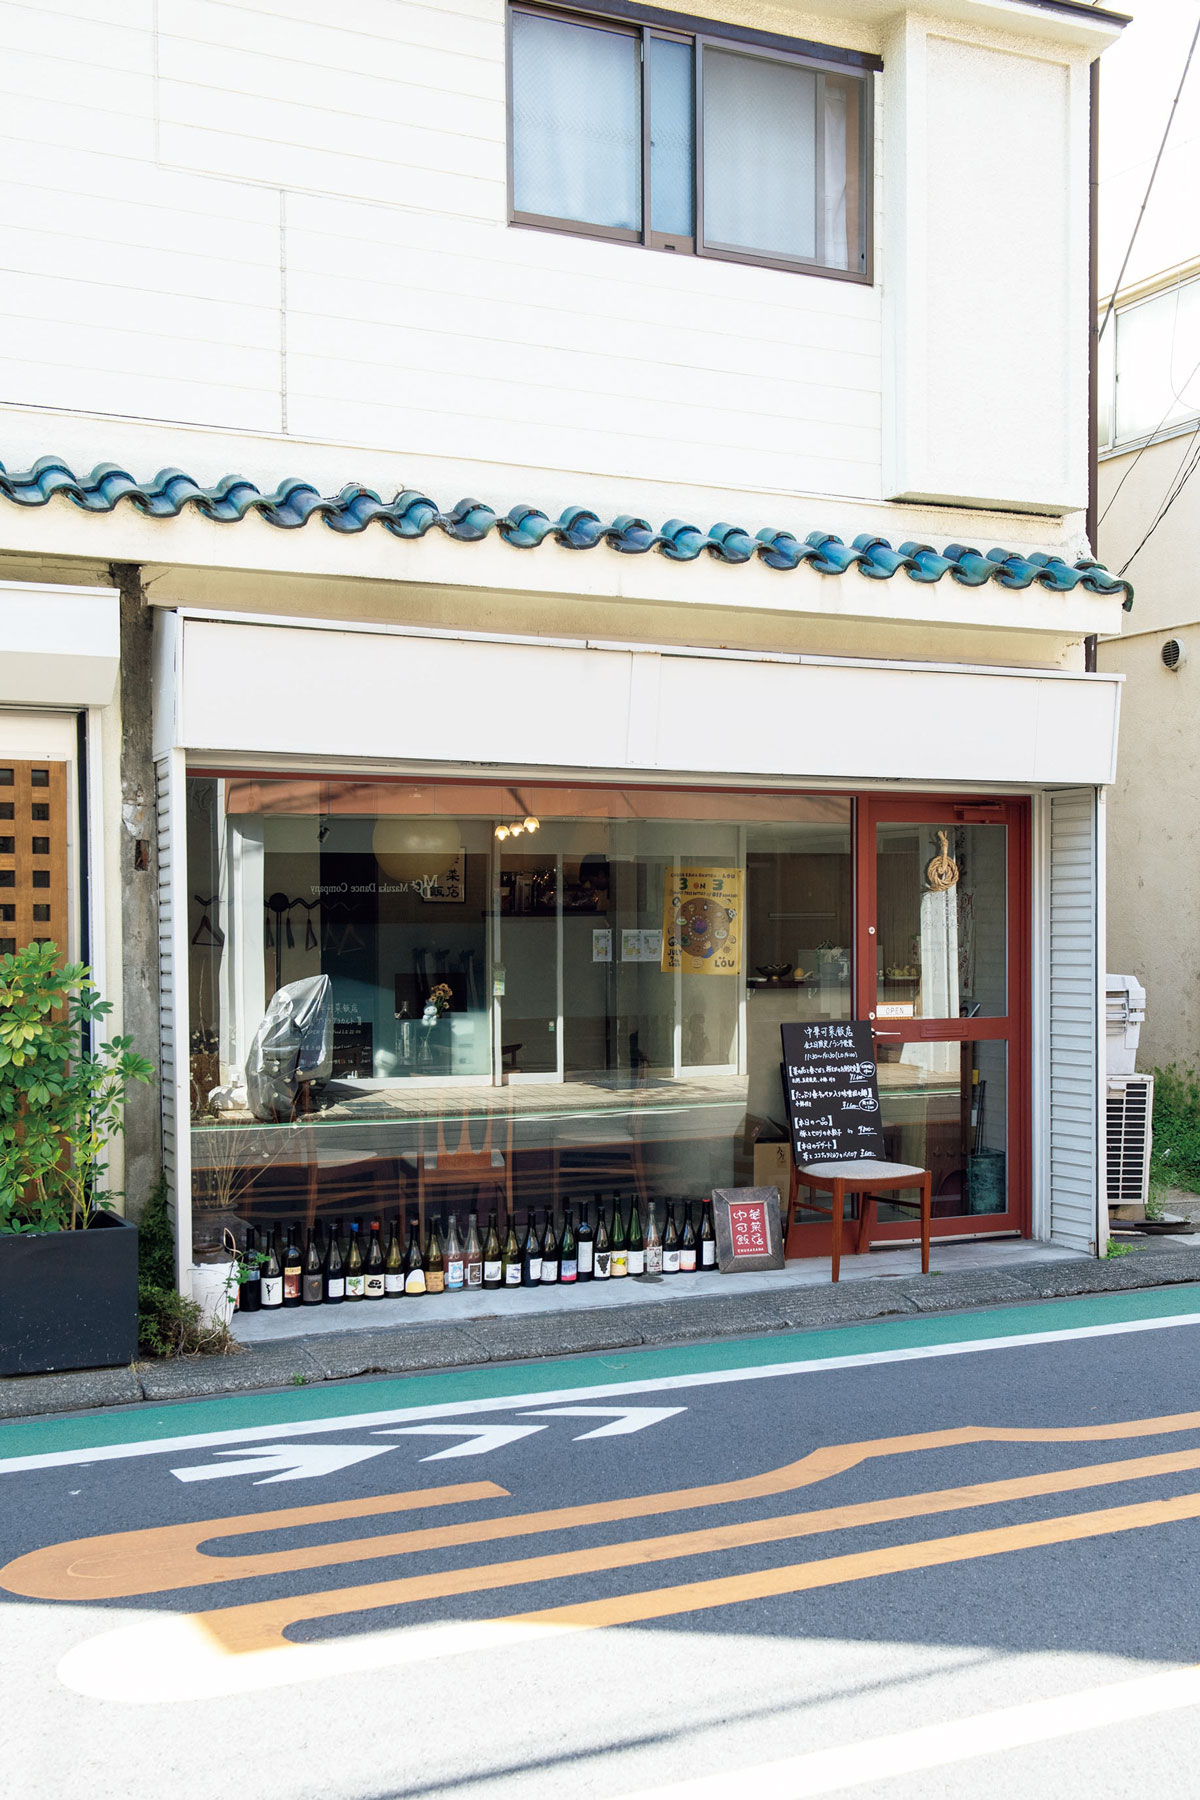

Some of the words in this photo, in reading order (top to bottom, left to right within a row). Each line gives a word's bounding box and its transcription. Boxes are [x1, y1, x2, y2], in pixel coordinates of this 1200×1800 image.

[679, 877, 688, 890] 3
[712, 878, 724, 890] 3
[886, 1007, 904, 1015] OPEN
[804, 1025, 854, 1039] 中華可菜飯店
